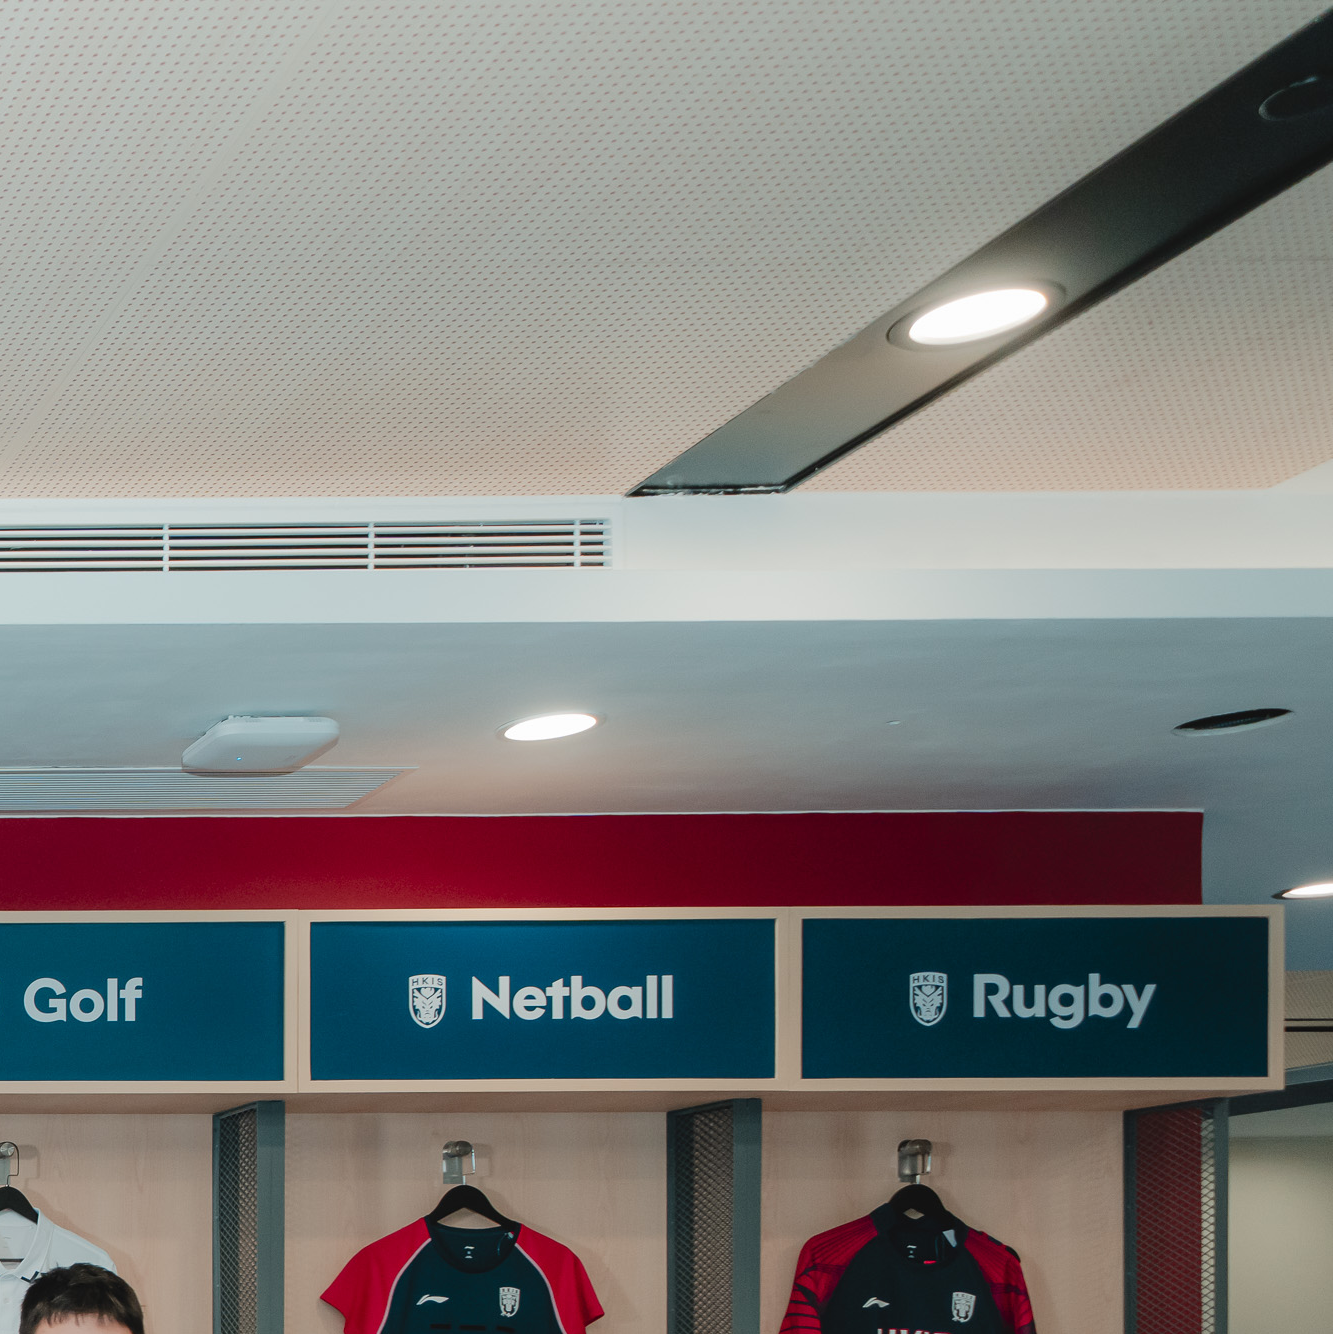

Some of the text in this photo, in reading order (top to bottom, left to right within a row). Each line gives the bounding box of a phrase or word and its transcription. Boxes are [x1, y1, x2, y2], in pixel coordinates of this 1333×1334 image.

[23, 977, 143, 1023] Golf
[411, 978, 444, 987] HKIS
[471, 974, 673, 1021] Netball
[912, 975, 944, 984] HKIS
[972, 973, 1157, 1029] Rugby
